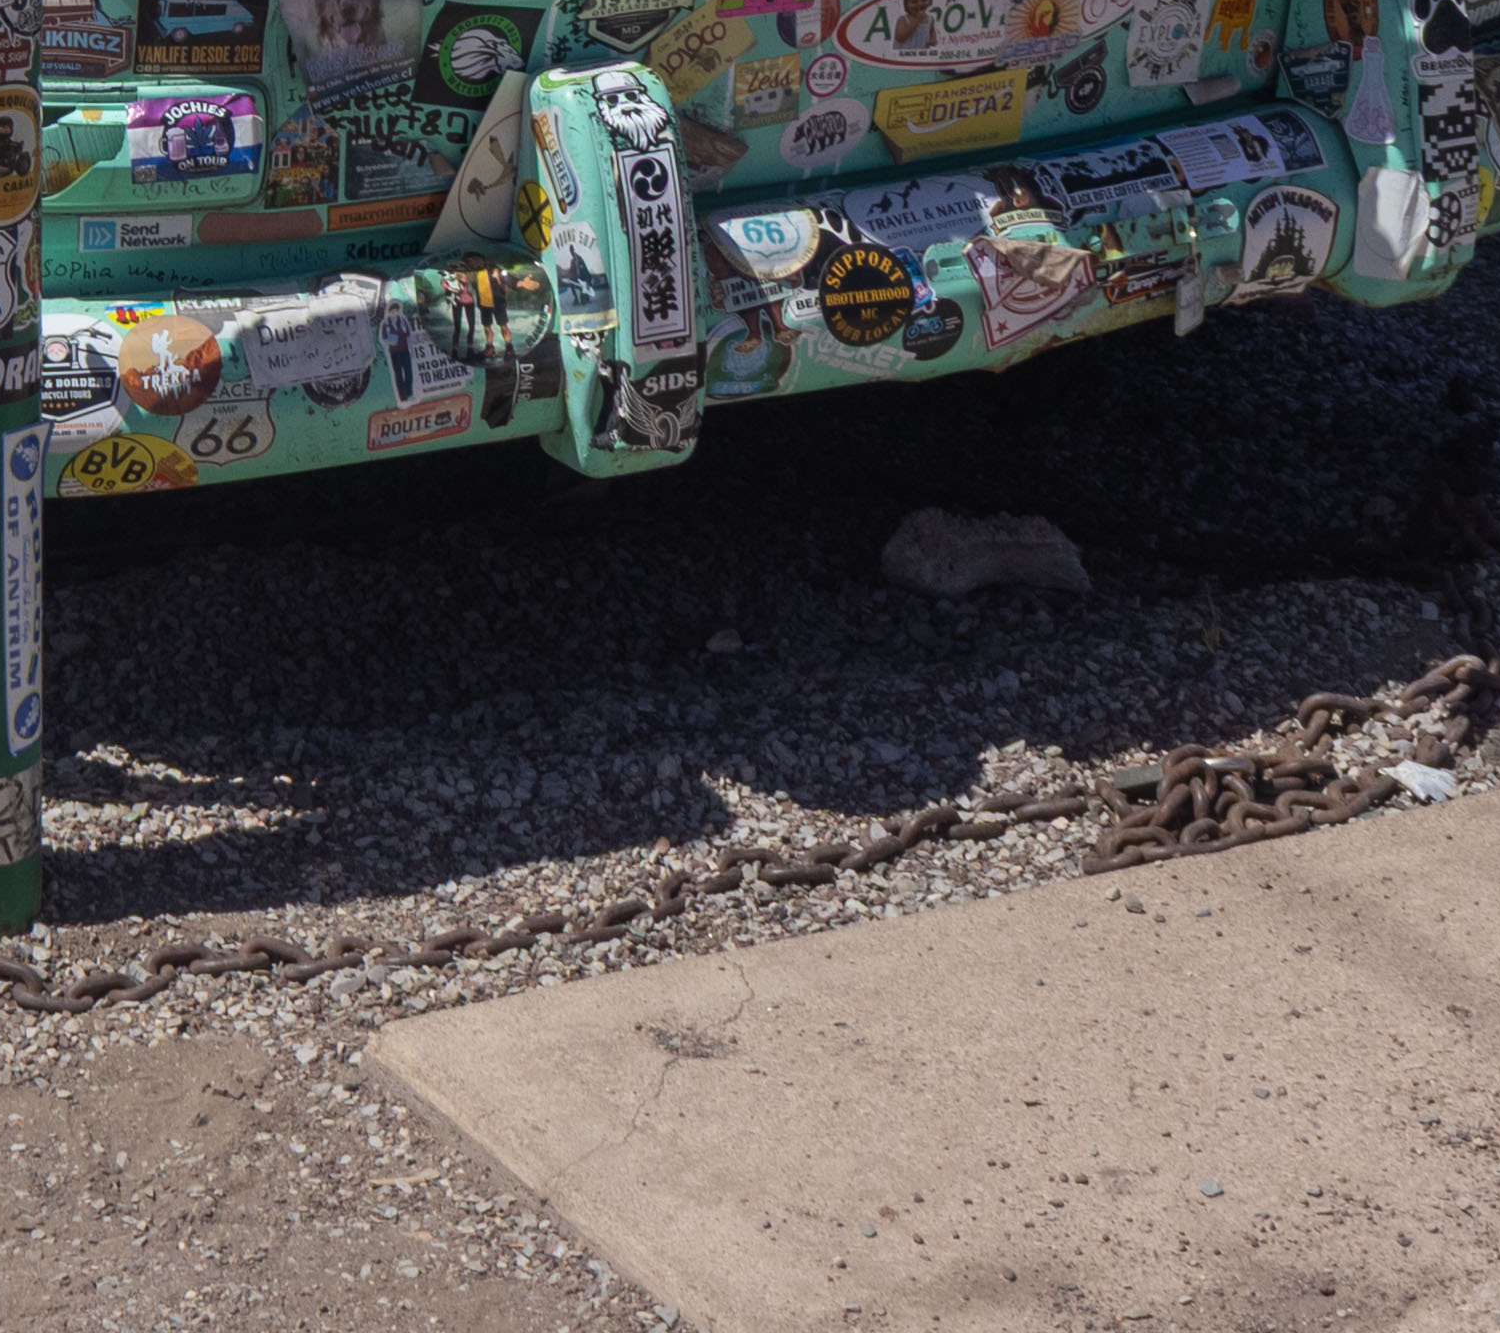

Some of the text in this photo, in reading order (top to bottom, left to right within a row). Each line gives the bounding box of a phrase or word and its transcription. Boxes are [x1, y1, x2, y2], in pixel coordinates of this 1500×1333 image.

[138, 44, 261, 64] VANLIFE DESDE 2012
[749, 69, 793, 91] Less
[933, 78, 1017, 99] FAHRSCHULE
[164, 100, 227, 124] JOCHIES
[931, 92, 1013, 124] DIETA 2
[177, 156, 228, 171] ON TOUR
[0, 178, 34, 193] CASAL
[1113, 177, 1177, 199] COFFEE COMPANY
[866, 197, 989, 232] TRAVEL & NATURE
[120, 222, 159, 236] Send
[120, 233, 187, 248] Network
[742, 219, 784, 245] 66
[824, 249, 904, 286] SUPPORT
[825, 284, 911, 308] BROTHERHOOD
[643, 373, 698, 396] SIDS
[190, 414, 258, 457] 66
[380, 415, 433, 439] ROUTE
[77, 438, 150, 485] BVB
[91, 478, 117, 492] 09
[7, 555, 23, 689] ANTRIM
